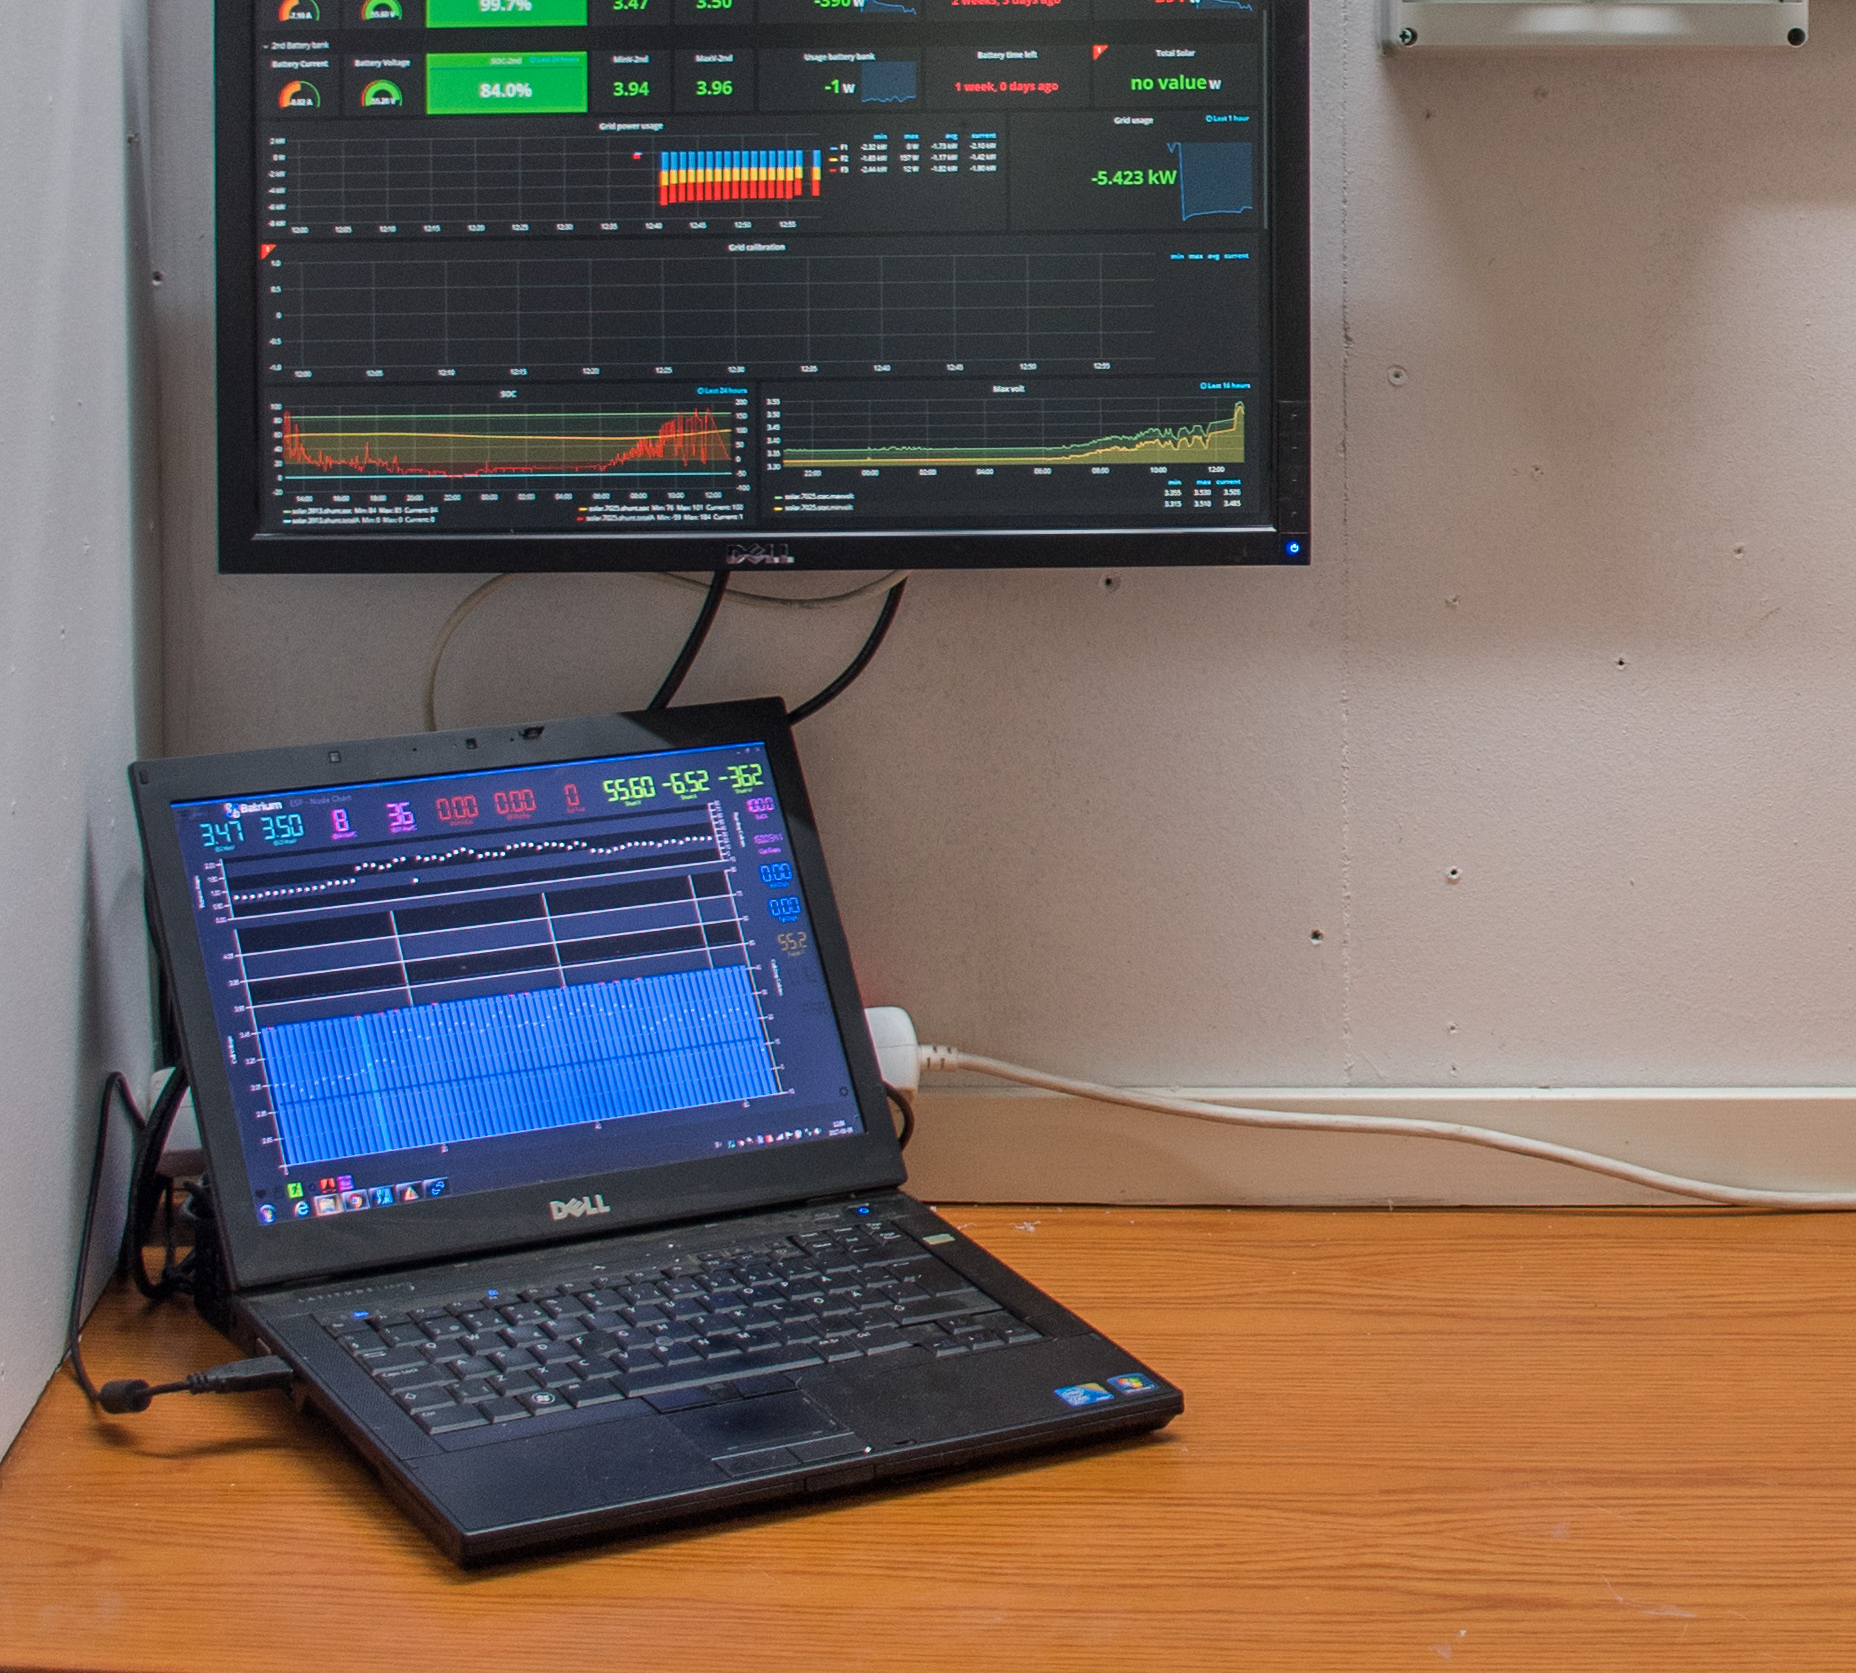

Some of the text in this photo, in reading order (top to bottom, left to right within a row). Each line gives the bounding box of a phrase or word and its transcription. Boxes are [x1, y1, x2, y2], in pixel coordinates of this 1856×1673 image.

[271, 41, 330, 51] 2nd Battery bank
[803, 52, 876, 63] Usage battery bank
[977, 50, 1038, 61] Battery time left
[1155, 49, 1196, 57] Total Solar
[271, 60, 329, 69] Battery Current
[353, 58, 411, 68] Battery Voltage
[695, 80, 733, 96] 3.96
[824, 78, 840, 94] -1
[955, 81, 1059, 94] 1 week, 0 days ago
[1130, 78, 1154, 91] no
[1157, 74, 1207, 91] value
[479, 82, 533, 98] 84.0%
[612, 81, 650, 97] 3.94
[599, 122, 664, 132] Grid power usage
[1114, 117, 1155, 126] Grid usage
[1091, 169, 1177, 186] -5.423 kW
[728, 243, 786, 252] Grid calibration
[1170, 252, 1185, 260] min
[1207, 253, 1220, 261] avg
[704, 387, 719, 395] Last
[728, 386, 748, 394] hours
[992, 385, 1026, 393] Max volt
[199, 820, 245, 847] 3.47
[260, 813, 305, 841] 3.50
[386, 801, 415, 827] 36
[435, 795, 479, 821] 0.00
[493, 789, 537, 815] 0.00
[564, 784, 580, 807] 0
[602, 776, 656, 802] 55.60
[661, 769, 711, 795] -6.52
[718, 763, 764, 789] -362
[240, 801, 283, 814] Batrium
[760, 863, 793, 883] 0.00
[768, 896, 801, 916] 0.00
[548, 1193, 612, 1221] DELL
